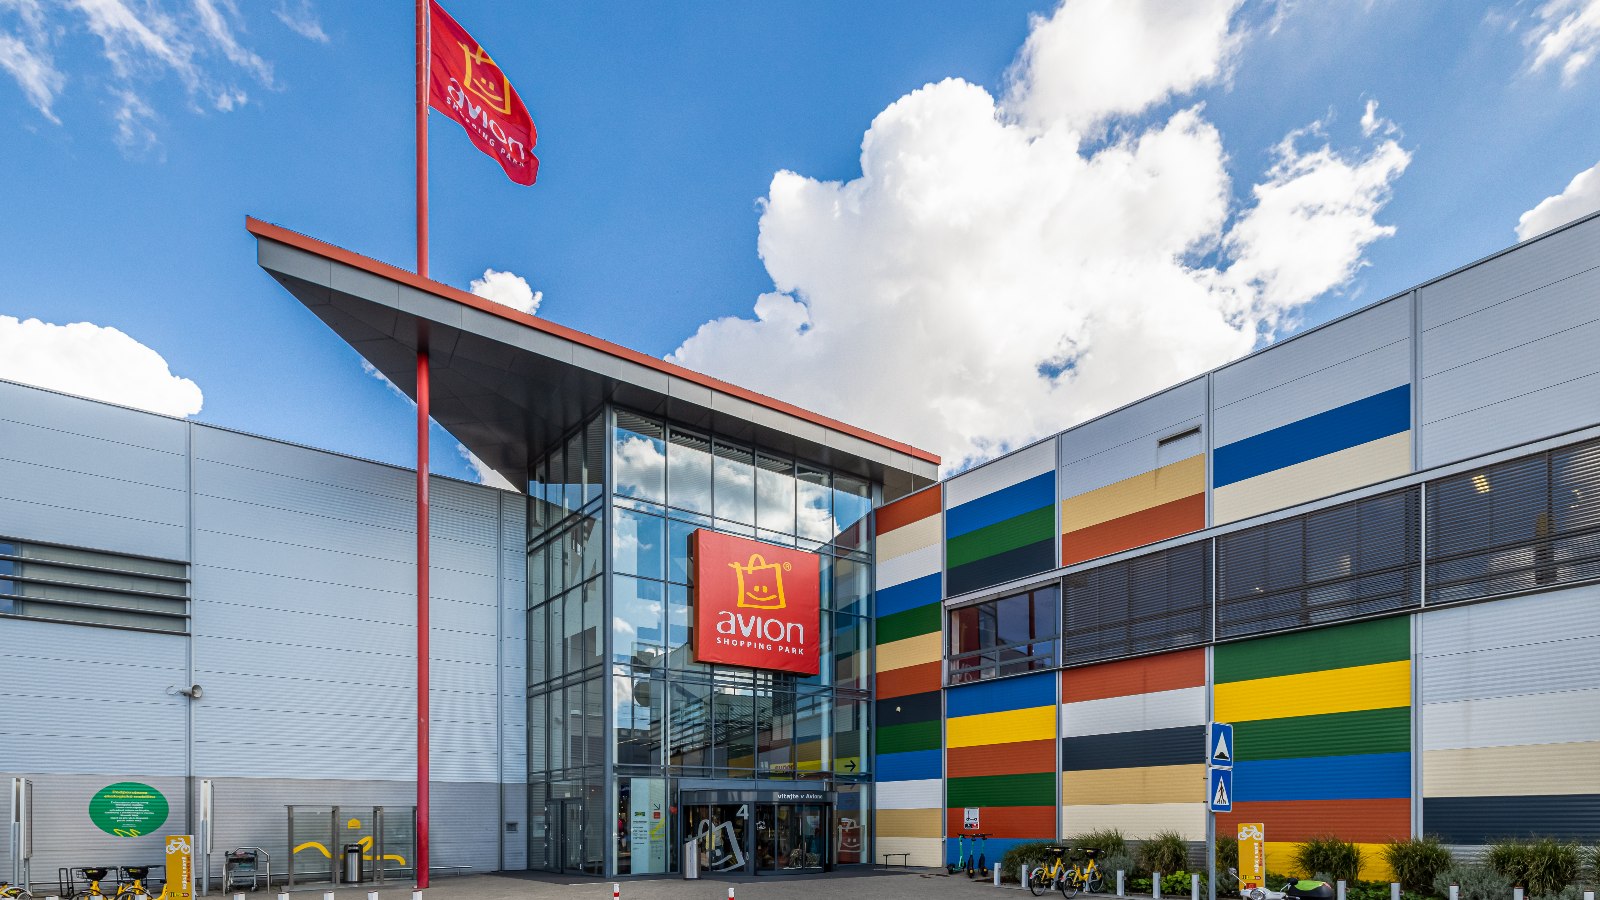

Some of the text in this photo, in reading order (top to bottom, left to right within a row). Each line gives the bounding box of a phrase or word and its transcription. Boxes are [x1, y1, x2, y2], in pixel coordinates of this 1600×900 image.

[447, 77, 525, 160] avion
[716, 610, 804, 645] avion
[716, 636, 804, 656] SHOPPING PARK
[777, 793, 799, 801] vitajte
[736, 804, 749, 820] 4
